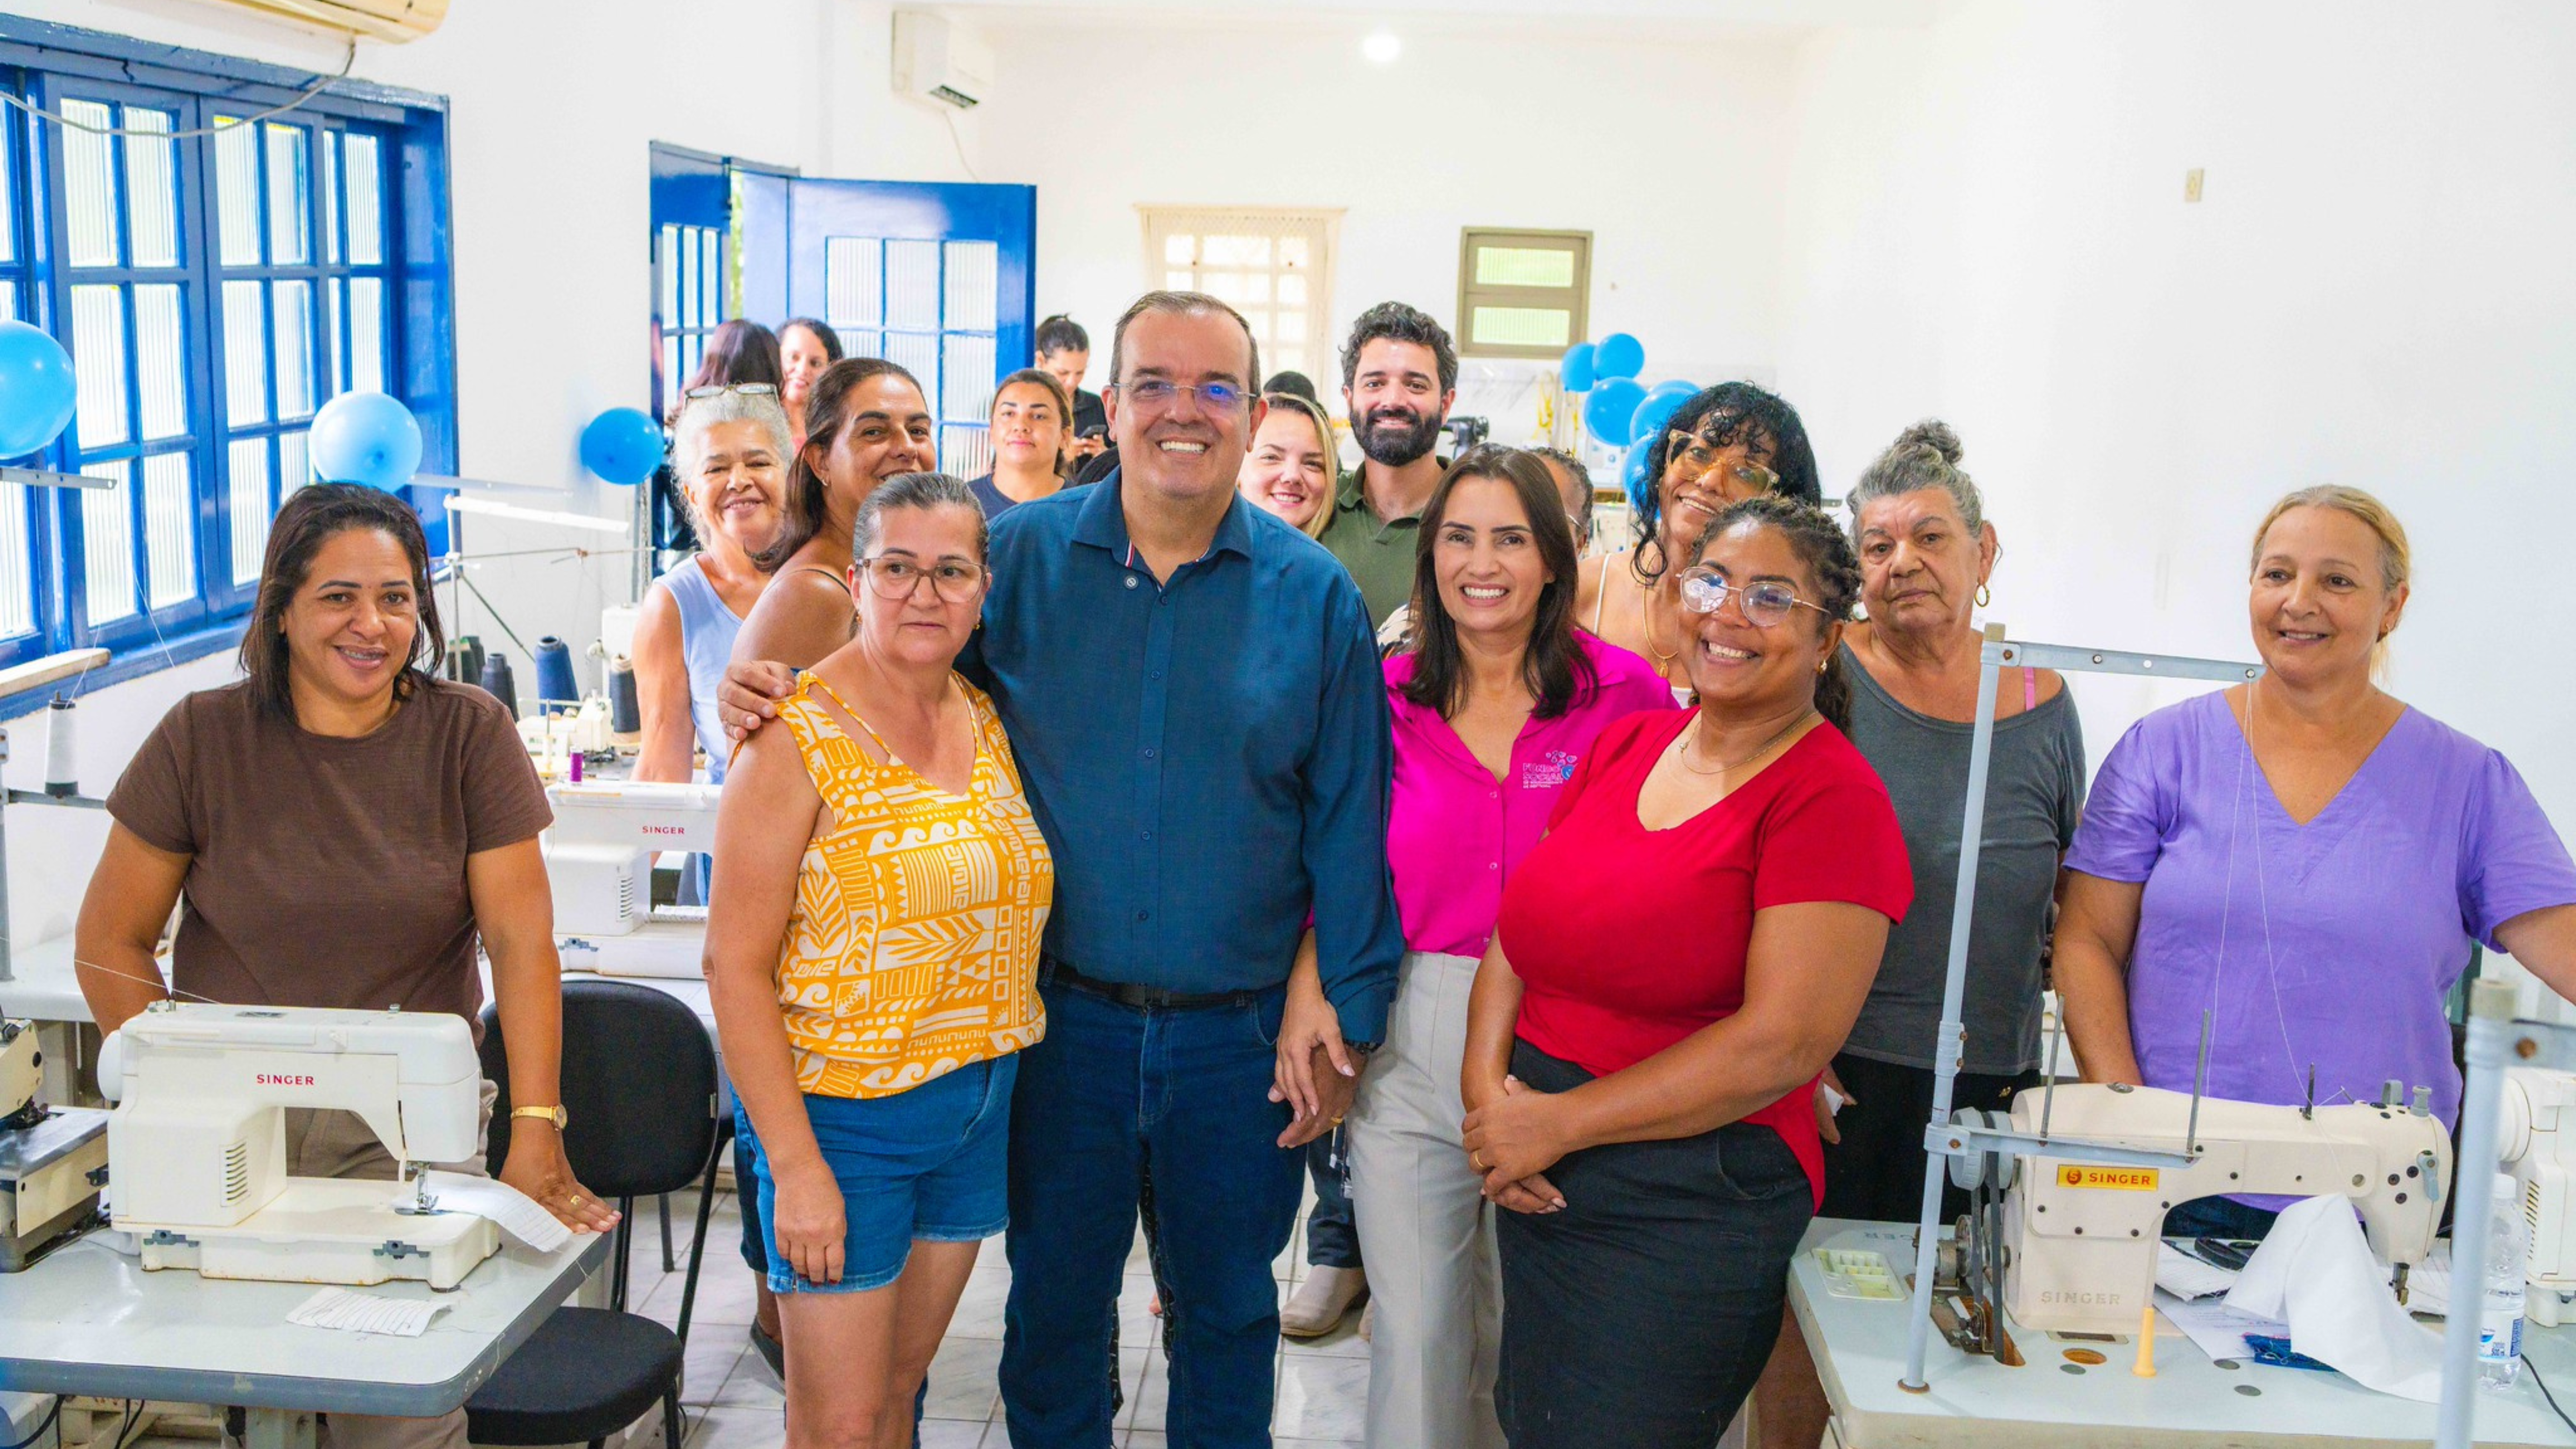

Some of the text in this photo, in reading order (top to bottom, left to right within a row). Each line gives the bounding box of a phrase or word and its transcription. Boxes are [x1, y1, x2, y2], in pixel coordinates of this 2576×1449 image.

[642, 826, 685, 834] SINGER
[257, 1074, 314, 1085] SINGER
[2089, 1173, 2150, 1185] SINGER
[2041, 1291, 2120, 1304] SINGER
